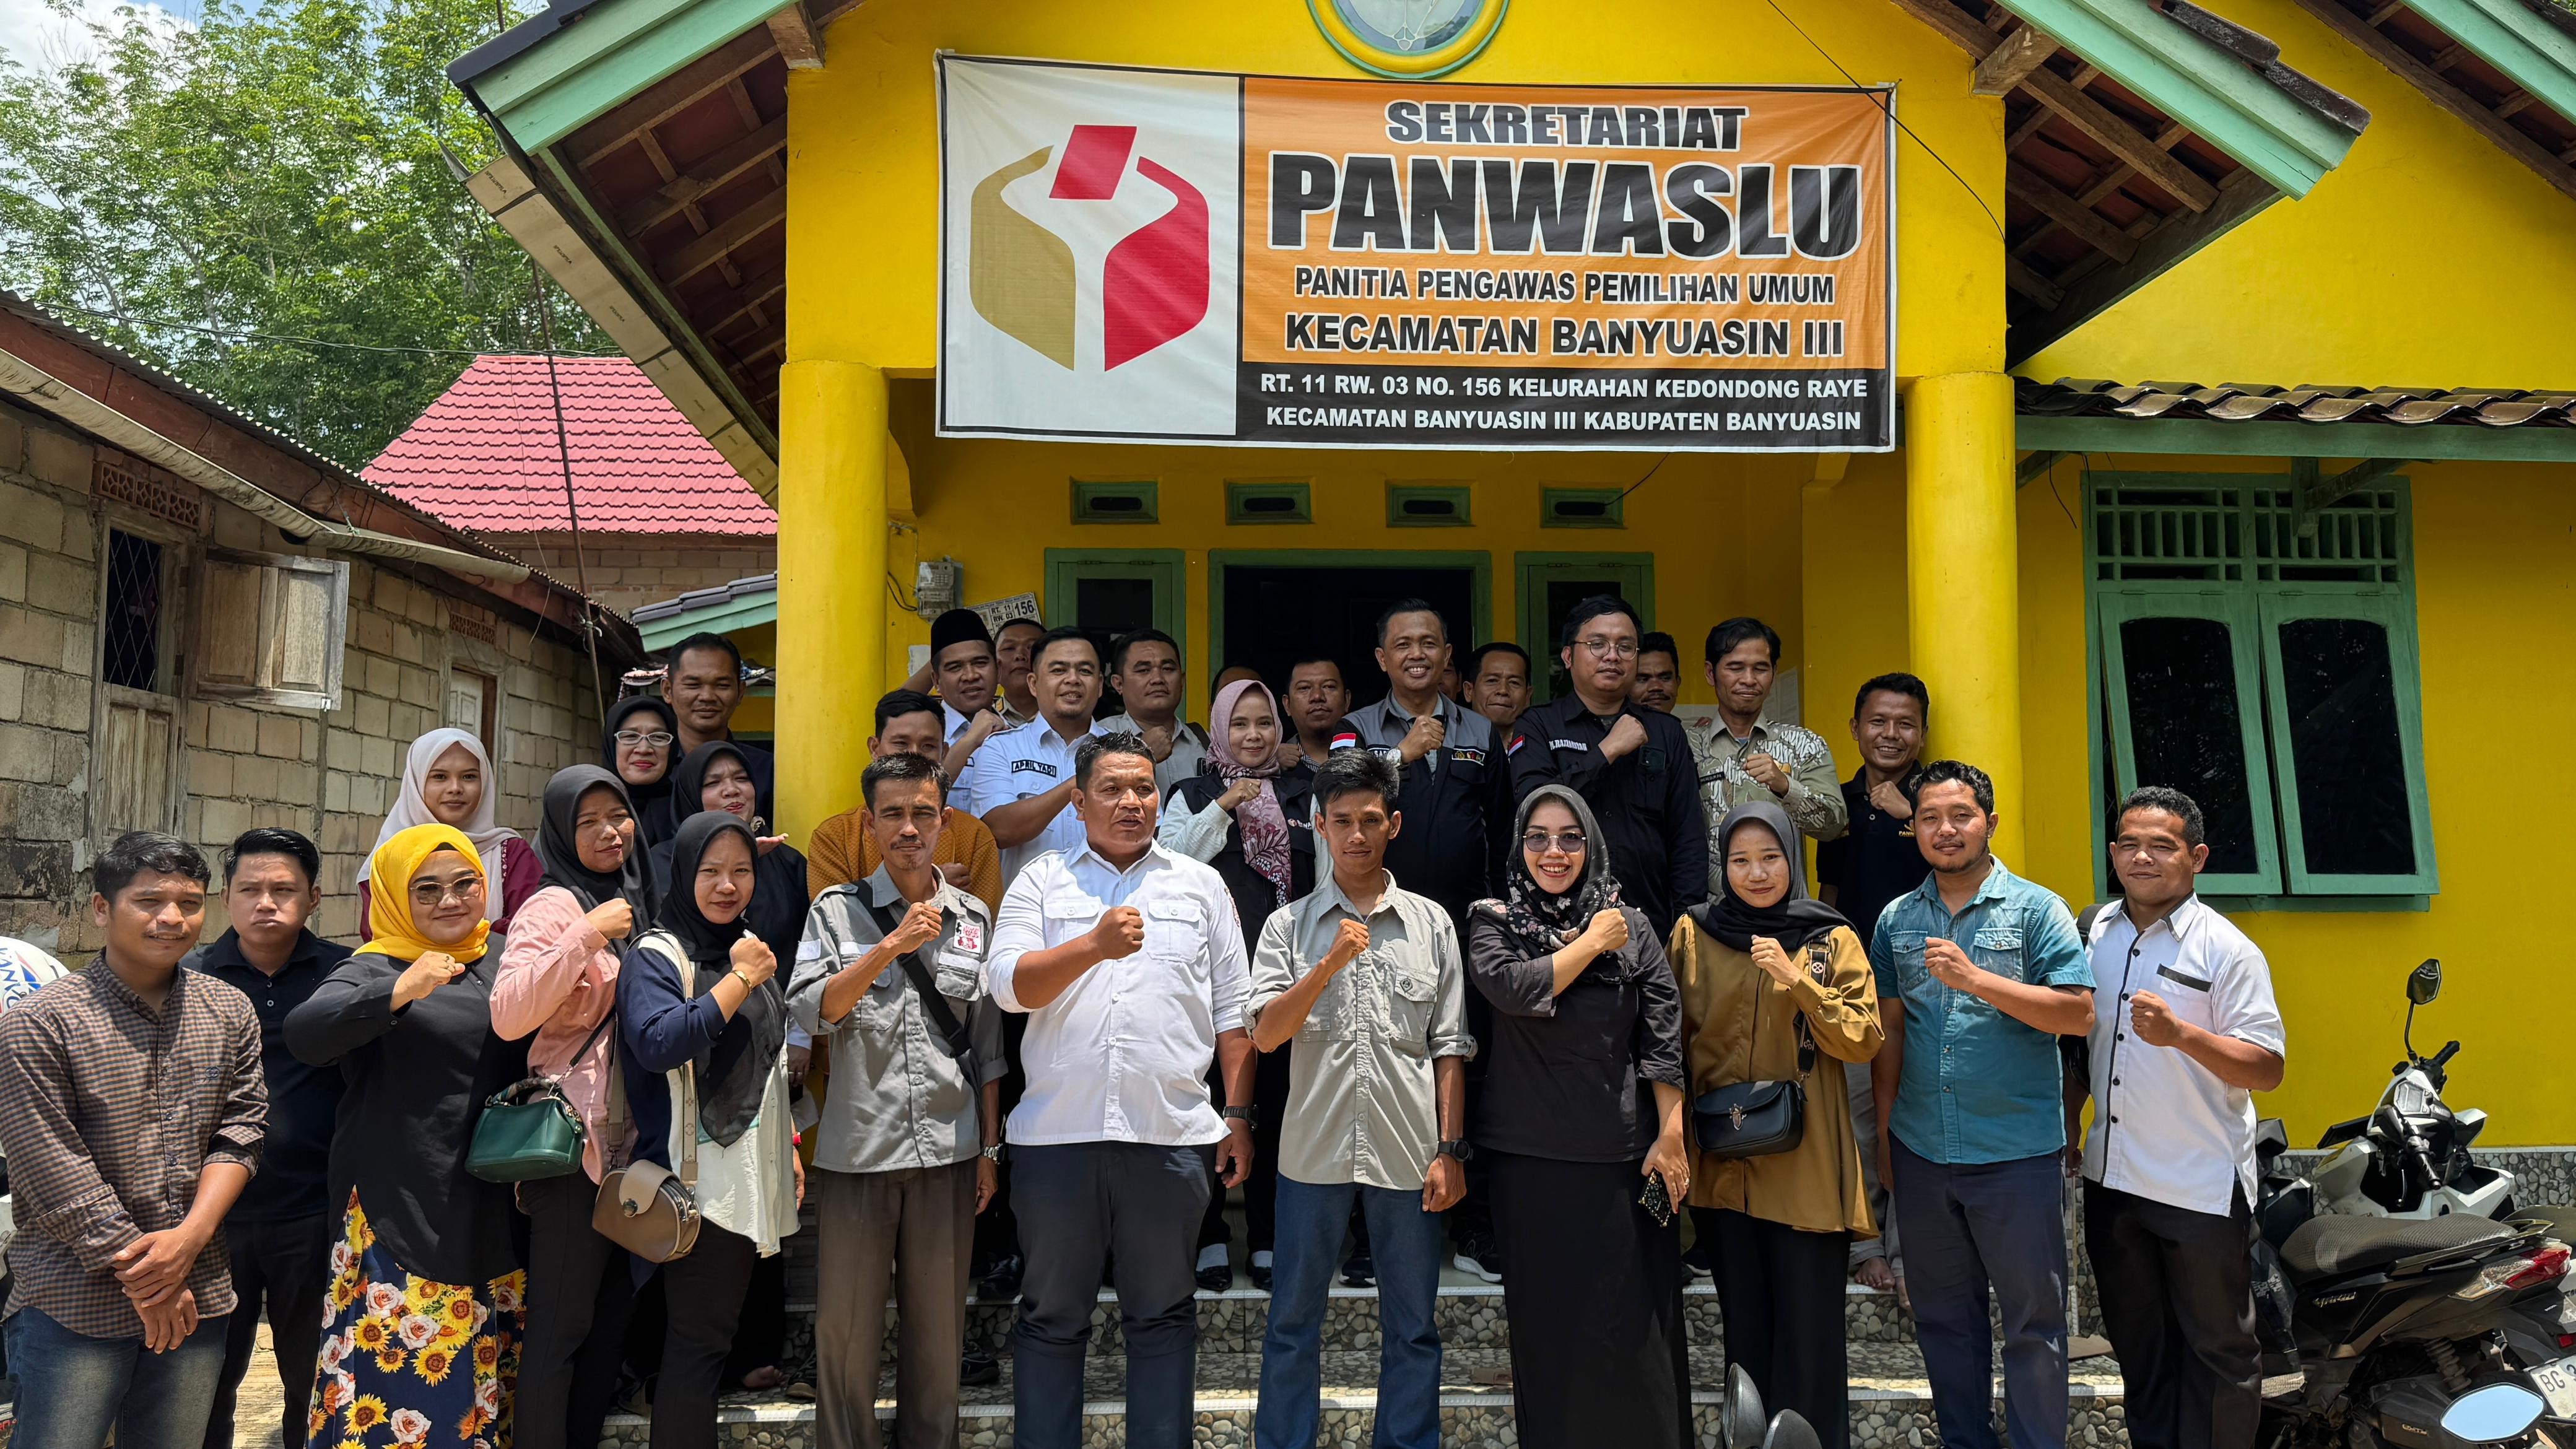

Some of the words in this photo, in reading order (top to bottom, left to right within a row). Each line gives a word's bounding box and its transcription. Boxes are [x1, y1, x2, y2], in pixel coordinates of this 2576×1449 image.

[1386, 101, 1747, 150] SEKRETARIAT
[1269, 152, 1860, 259] PANWASLU
[1295, 267, 1409, 298] PANITIA
[1417, 270, 1575, 301] PENGAWAS
[1584, 273, 1738, 303] PEMILIHAN
[1748, 274, 1834, 303] UMUM
[1286, 314, 1538, 354] KECAMATAN
[1552, 319, 1788, 355] BANYUASIN
[1803, 321, 1843, 356] III
[1261, 373, 1294, 393] RT.
[1302, 373, 1326, 393] 11
[1334, 375, 1375, 394] RW.
[1382, 375, 1409, 395] 03
[1416, 376, 1455, 396] NO.
[1462, 377, 1502, 396] 156
[1508, 378, 1648, 398] KELURAHAN
[1655, 379, 1800, 398] KEDONDONG
[1808, 379, 1868, 398] RAYE
[1267, 406, 1407, 428] KECAMATAN
[1414, 409, 1547, 429] BANYUASIN
[1554, 411, 1577, 430] III
[1584, 411, 1718, 431] KABUPATEN
[1726, 411, 1861, 431] BANYUASIN
[991, 607, 1001, 615] RT.
[1014, 599, 1035, 616] 156
[1014, 760, 1036, 771] APRIL
[2539, 1370, 2565, 1392] BG
